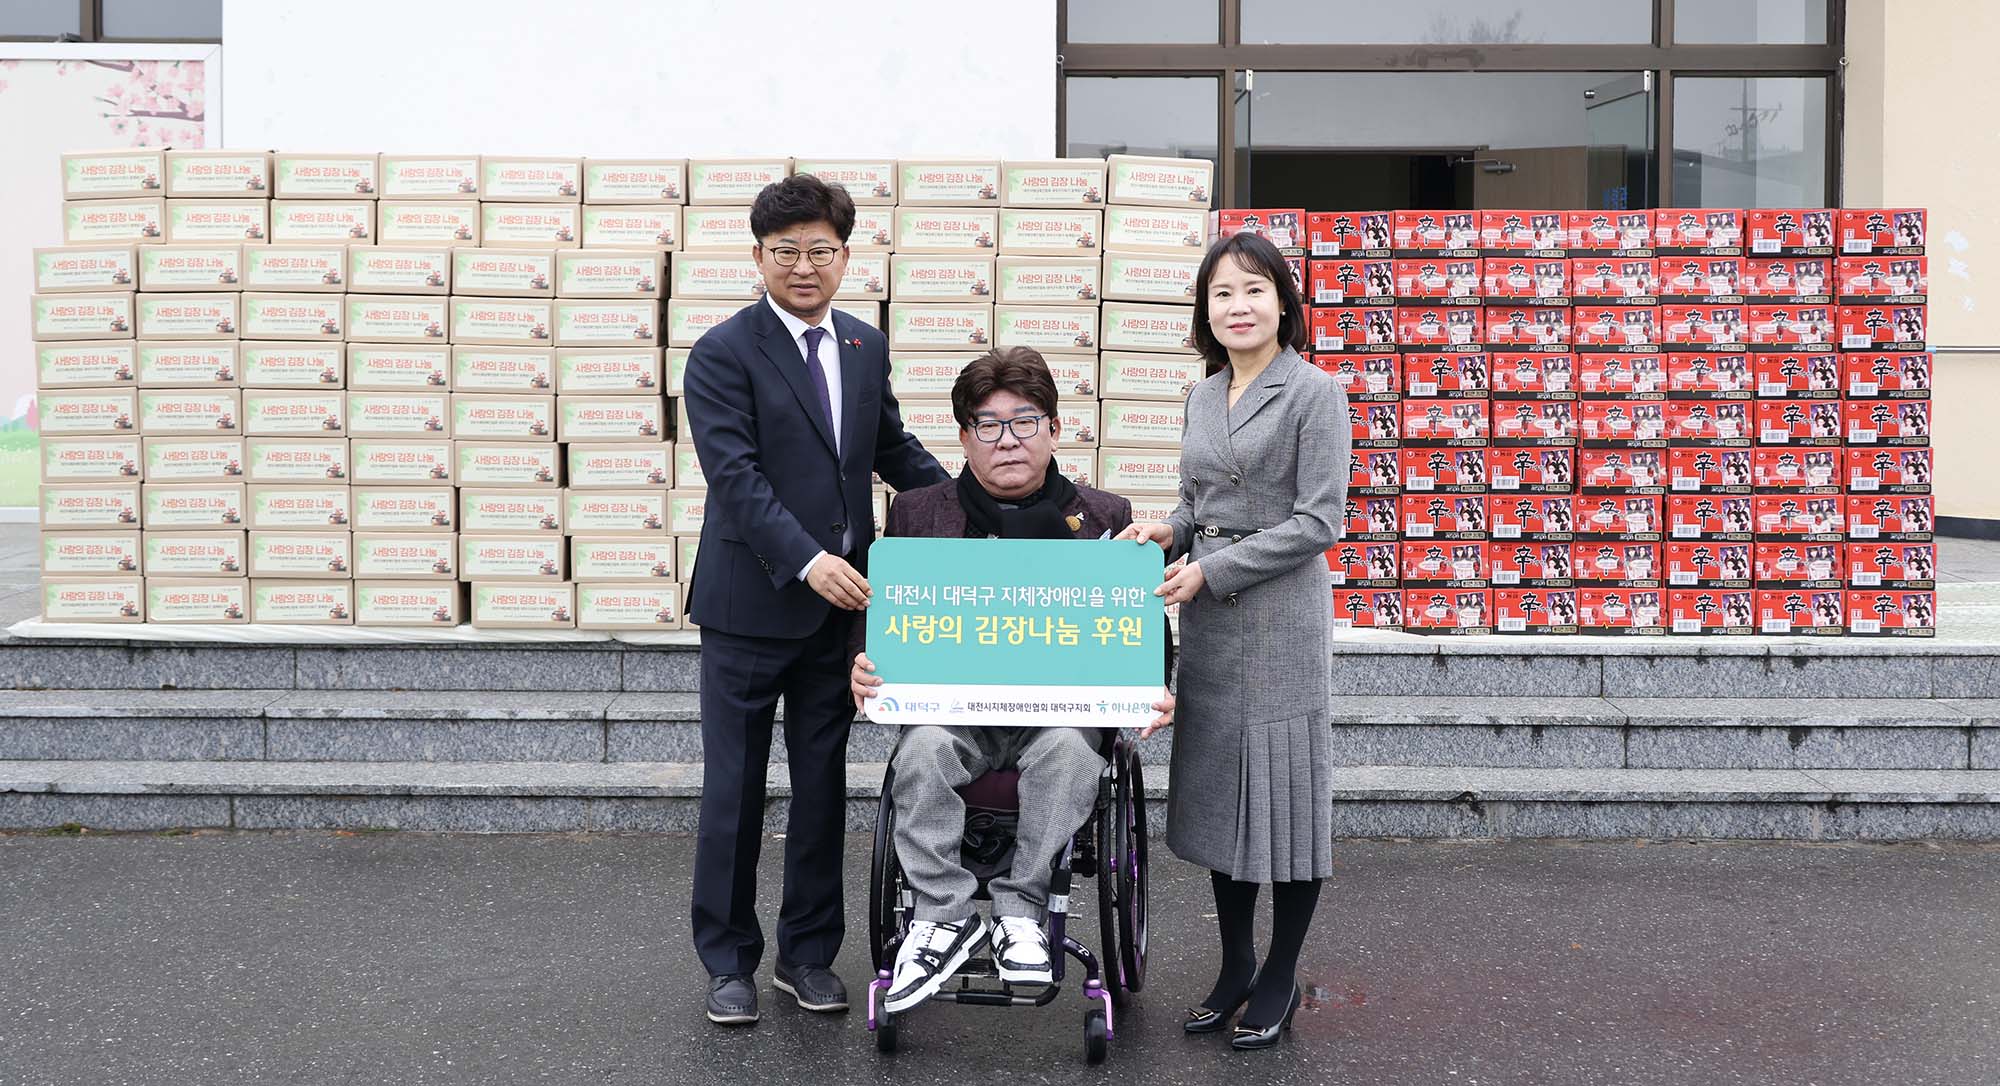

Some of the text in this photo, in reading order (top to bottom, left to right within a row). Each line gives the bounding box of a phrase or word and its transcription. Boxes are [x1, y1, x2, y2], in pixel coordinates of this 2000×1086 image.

[81, 165, 145, 175] 사랑의 김장 나눔
[294, 167, 359, 177] 사랑의 김장 나눔
[500, 170, 563, 180] 사랑의 김장 나눔
[918, 174, 983, 183] 사랑의 김장 나눔
[1022, 177, 1087, 187] 사랑의 김장 나눔
[1130, 172, 1194, 185] 사랑의 김장 나눔
[915, 221, 980, 231] 사랑의 김장 나눔
[1017, 221, 1081, 231] 사랑의 김장 나눔
[1124, 218, 1188, 230] 사랑의 김장 나눔
[1775, 213, 1797, 242] 辛
[1866, 213, 1888, 242] 辛
[1333, 216, 1355, 245] 辛
[263, 258, 327, 268] 사랑의 김장 나눔
[576, 266, 640, 276] 사랑의 김장 나눔
[910, 270, 975, 279] 사랑의 김장 나눔
[1125, 268, 1189, 279] 사랑의 김장 나눔
[1017, 274, 1082, 284] 사랑의 김장 나눔
[1337, 264, 1358, 292] 辛
[50, 306, 114, 316] 사랑의 김장 나눔
[470, 311, 534, 322] 사랑의 김장 나눔
[909, 317, 973, 327] 사랑의 김장 나눔
[1014, 320, 1079, 330] 사랑의 김장 나눔
[1122, 319, 1186, 331] 사랑의 김장 나눔
[1337, 311, 1359, 340] 辛
[1865, 309, 1887, 338] 辛
[155, 356, 219, 365] 사랑의 김장 나눔
[367, 359, 432, 369] 사랑의 김장 나눔
[1121, 367, 1186, 379] 사랑의 김장 나눔
[1431, 357, 1453, 386] 辛
[1781, 357, 1802, 386] 辛
[1872, 357, 1894, 385] 辛
[54, 404, 118, 413] 사랑의 김장 나눔
[578, 410, 642, 420] 사랑의 김장 나눔
[1783, 404, 1804, 433] 辛
[1871, 404, 1893, 432] 辛
[163, 451, 227, 461] 사랑의 김장 나눔
[369, 453, 434, 462] 사랑의 김장 나눔
[1428, 451, 1450, 480] 辛
[1513, 451, 1535, 479] 辛
[1694, 452, 1716, 480] 辛
[1873, 451, 1895, 480] 辛
[58, 498, 122, 507] 사랑의 김장 나눔
[268, 499, 333, 508] 사랑의 김장 나눔
[479, 503, 544, 513] 사랑의 김장 나눔
[1340, 500, 1361, 528] 辛
[1428, 498, 1450, 527] 辛
[1515, 499, 1537, 528] 辛
[1695, 499, 1716, 528] 辛
[1873, 499, 1895, 528] 辛
[160, 546, 225, 555] 사랑의 김장 나눔
[591, 551, 655, 561] 사랑의 김장 나눔
[1339, 546, 1361, 575] 辛
[1514, 545, 1536, 574] 辛
[1692, 546, 1714, 575] 辛
[1875, 547, 1897, 575] 辛
[60, 591, 124, 601] 사랑의 김장 나눔
[372, 596, 437, 605] 사랑의 김장 나눔
[886, 584, 1146, 609] 대전시 대덕구 지체장애인을 위한
[1346, 593, 1368, 622] 辛
[1520, 592, 1542, 621] 辛
[1695, 594, 1717, 622] 辛
[1784, 593, 1806, 622] 辛
[1874, 594, 1896, 623] 辛
[884, 614, 1143, 646] 사랑의 김장나눔 후원
[905, 702, 940, 712] 대덕구
[967, 702, 1091, 713] 대전시지체장애인협회 대덕구지회
